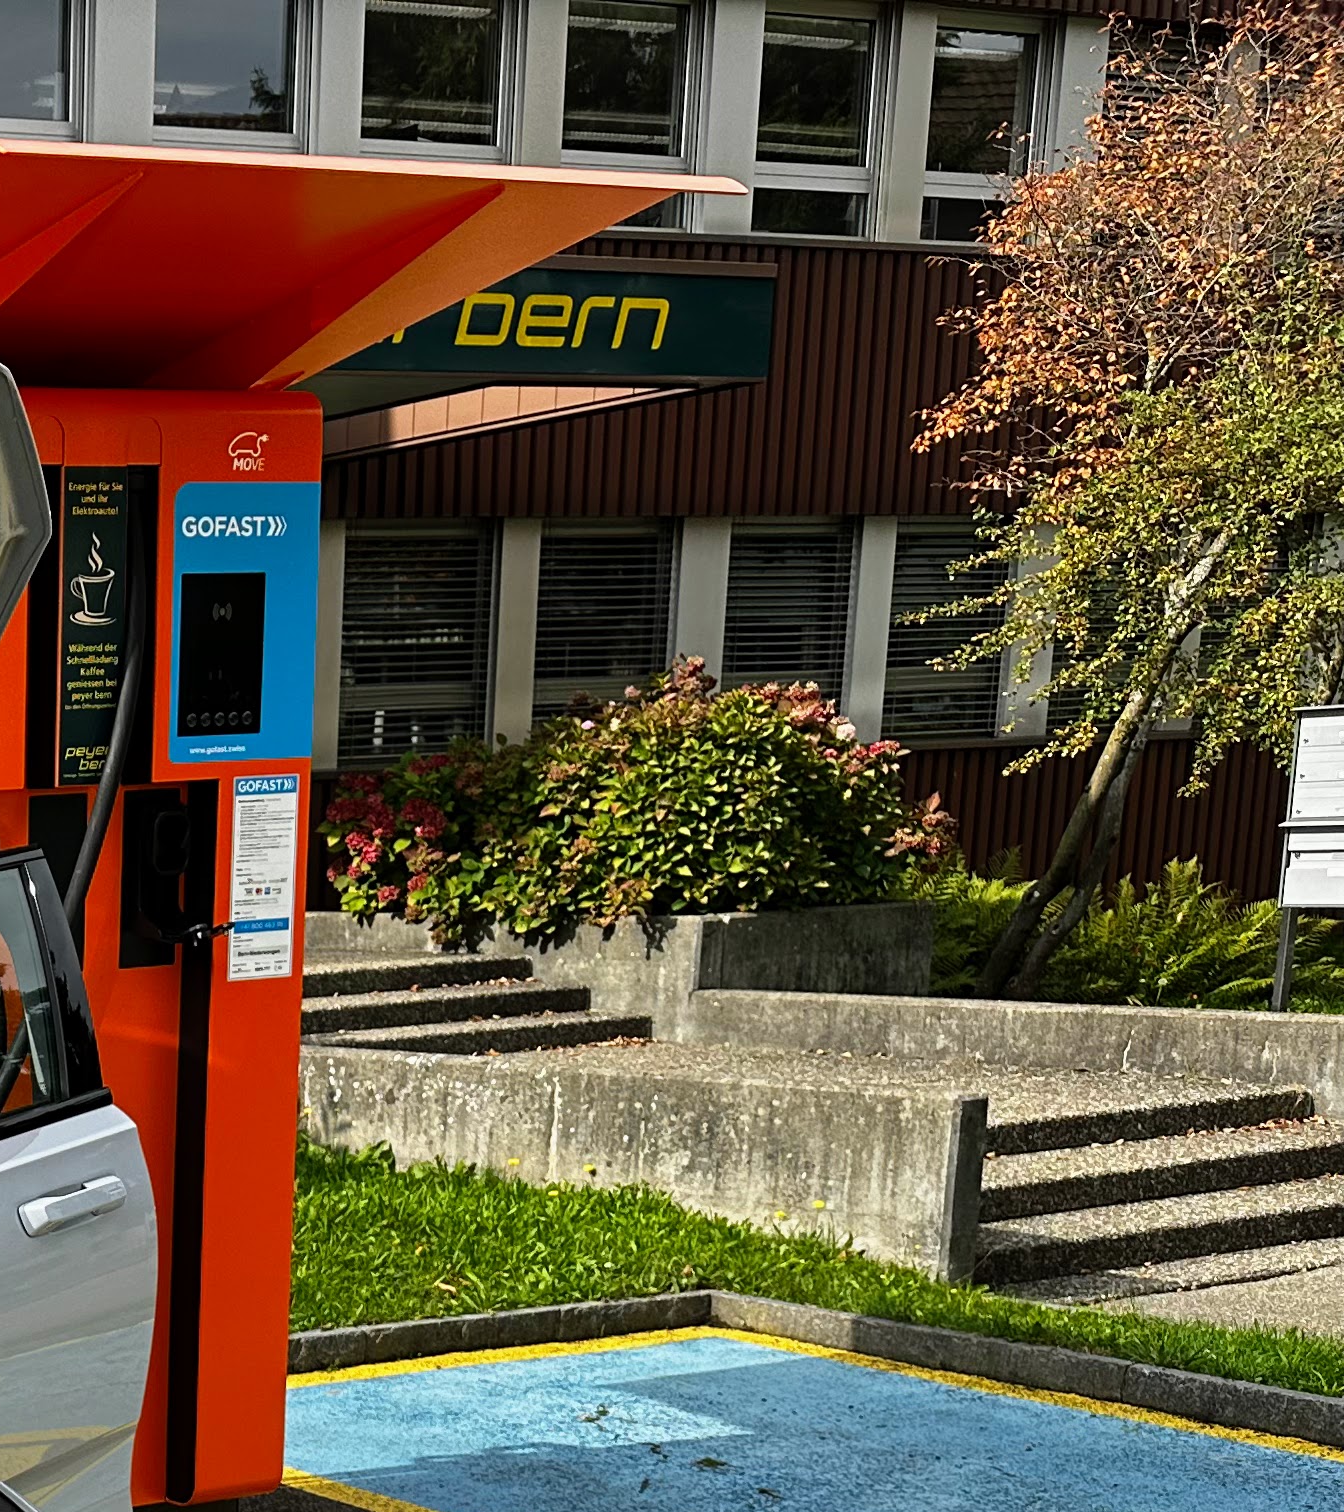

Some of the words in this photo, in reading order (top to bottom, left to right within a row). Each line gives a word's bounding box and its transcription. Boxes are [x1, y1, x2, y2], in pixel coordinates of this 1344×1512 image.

[232, 457, 266, 471] MOVE
[68, 482, 97, 493] Energie
[98, 481, 110, 491] für
[182, 515, 266, 538] GOFAST
[68, 643, 103, 653] Während
[104, 643, 117, 652] der
[80, 666, 105, 676] Kaffee
[105, 678, 117, 687] bei
[237, 780, 283, 793] GOFAST
